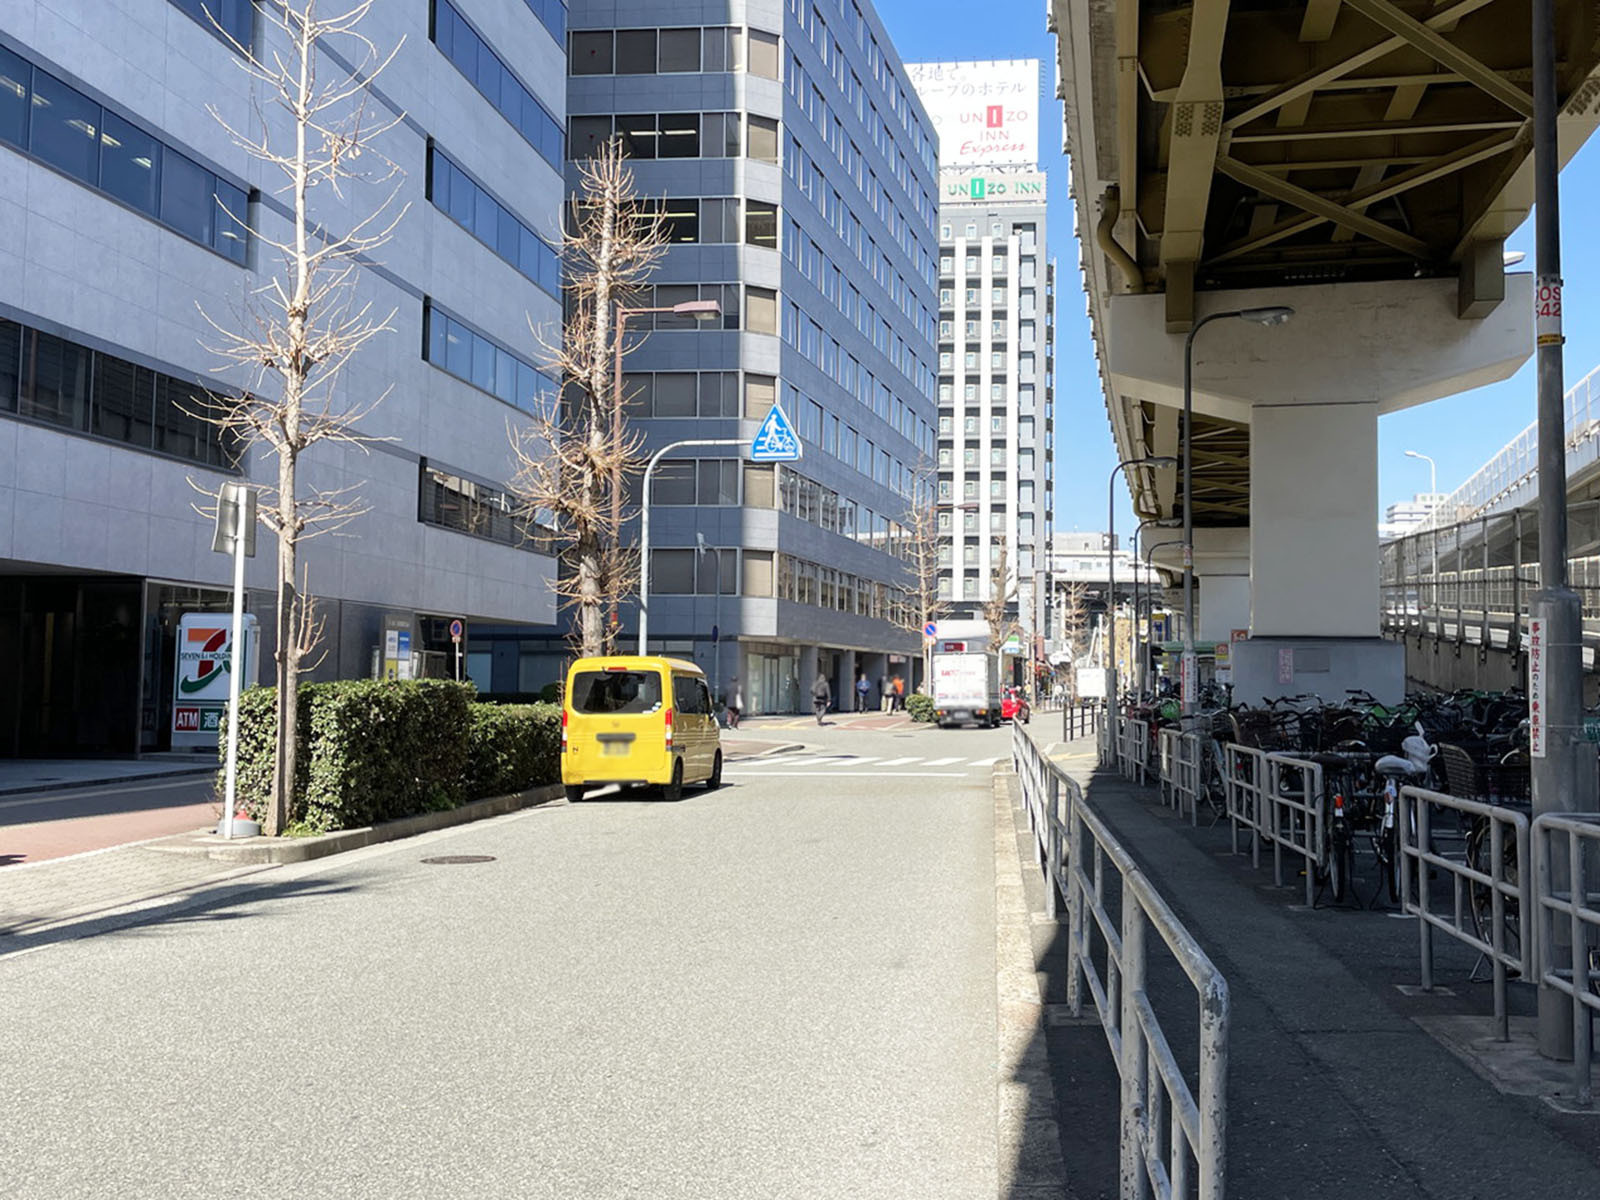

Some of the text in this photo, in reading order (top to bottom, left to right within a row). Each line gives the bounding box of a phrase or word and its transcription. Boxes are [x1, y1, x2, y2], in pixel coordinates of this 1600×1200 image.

[960, 105, 1028, 127] UNIZO
[979, 130, 1010, 142] INN
[960, 141, 1026, 157] Express
[947, 179, 1042, 198] UNIZO INN
[1536, 286, 1561, 302] OS
[180, 652, 200, 661] SEVEN
[177, 712, 198, 727] ATM
[203, 711, 219, 728] 酒
